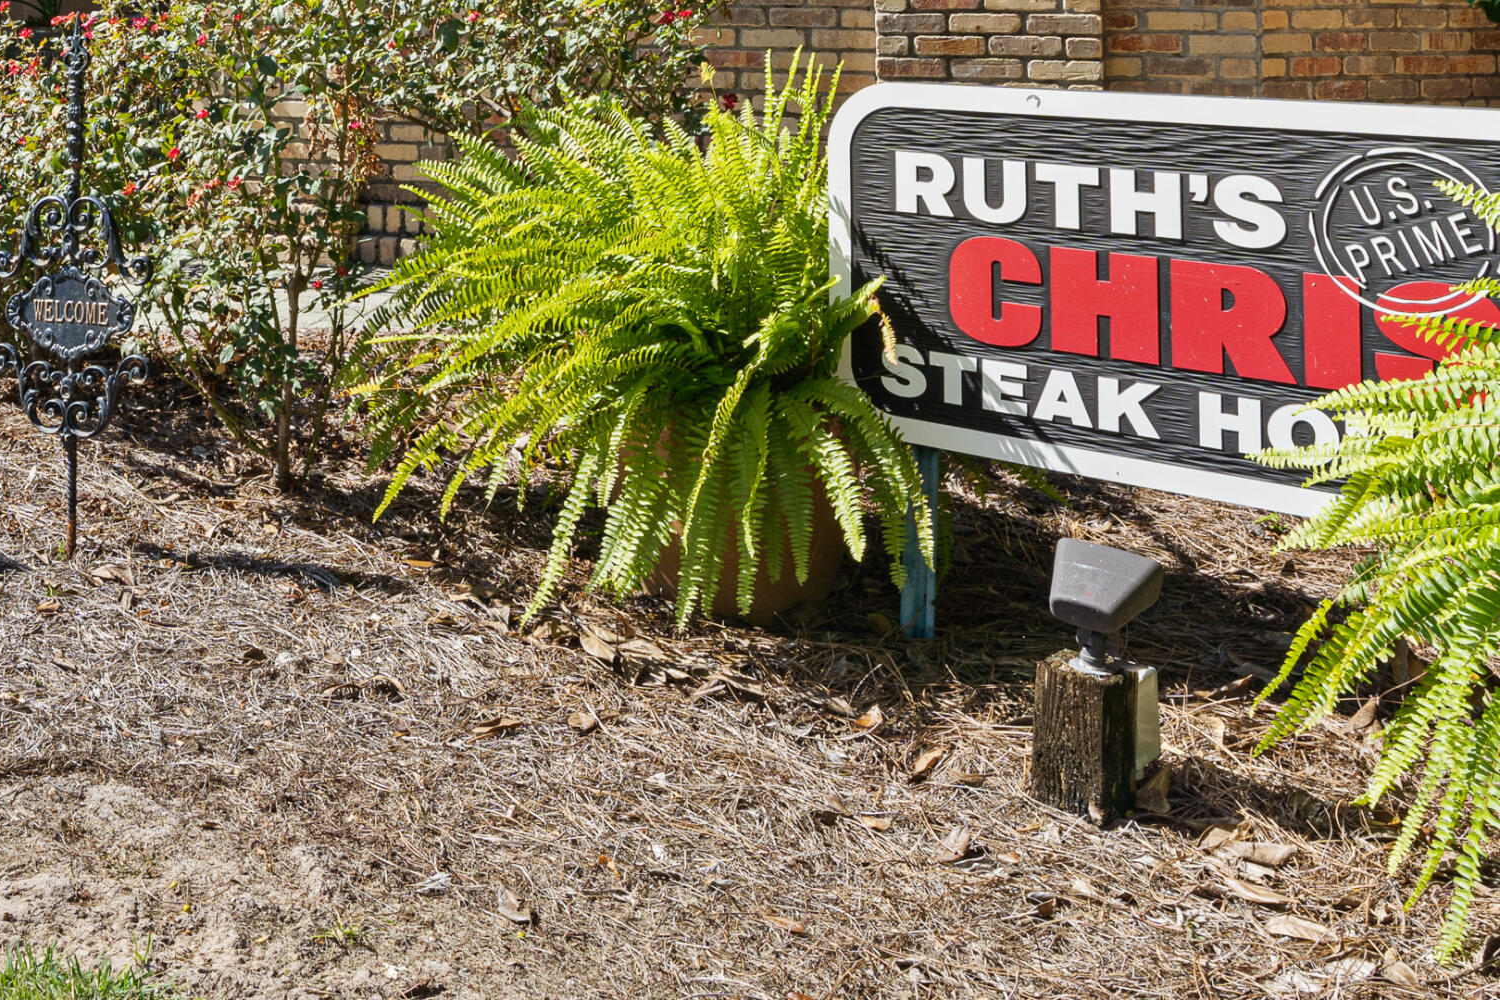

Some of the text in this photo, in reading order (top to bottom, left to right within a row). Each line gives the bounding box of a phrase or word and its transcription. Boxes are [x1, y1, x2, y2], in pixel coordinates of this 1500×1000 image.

[895, 150, 1287, 249] RUTH'S
[1350, 177, 1433, 225] U.S.
[1345, 212, 1484, 283] PRIME
[33, 299, 109, 325] WELCOME
[881, 346, 1162, 439] STEAK
